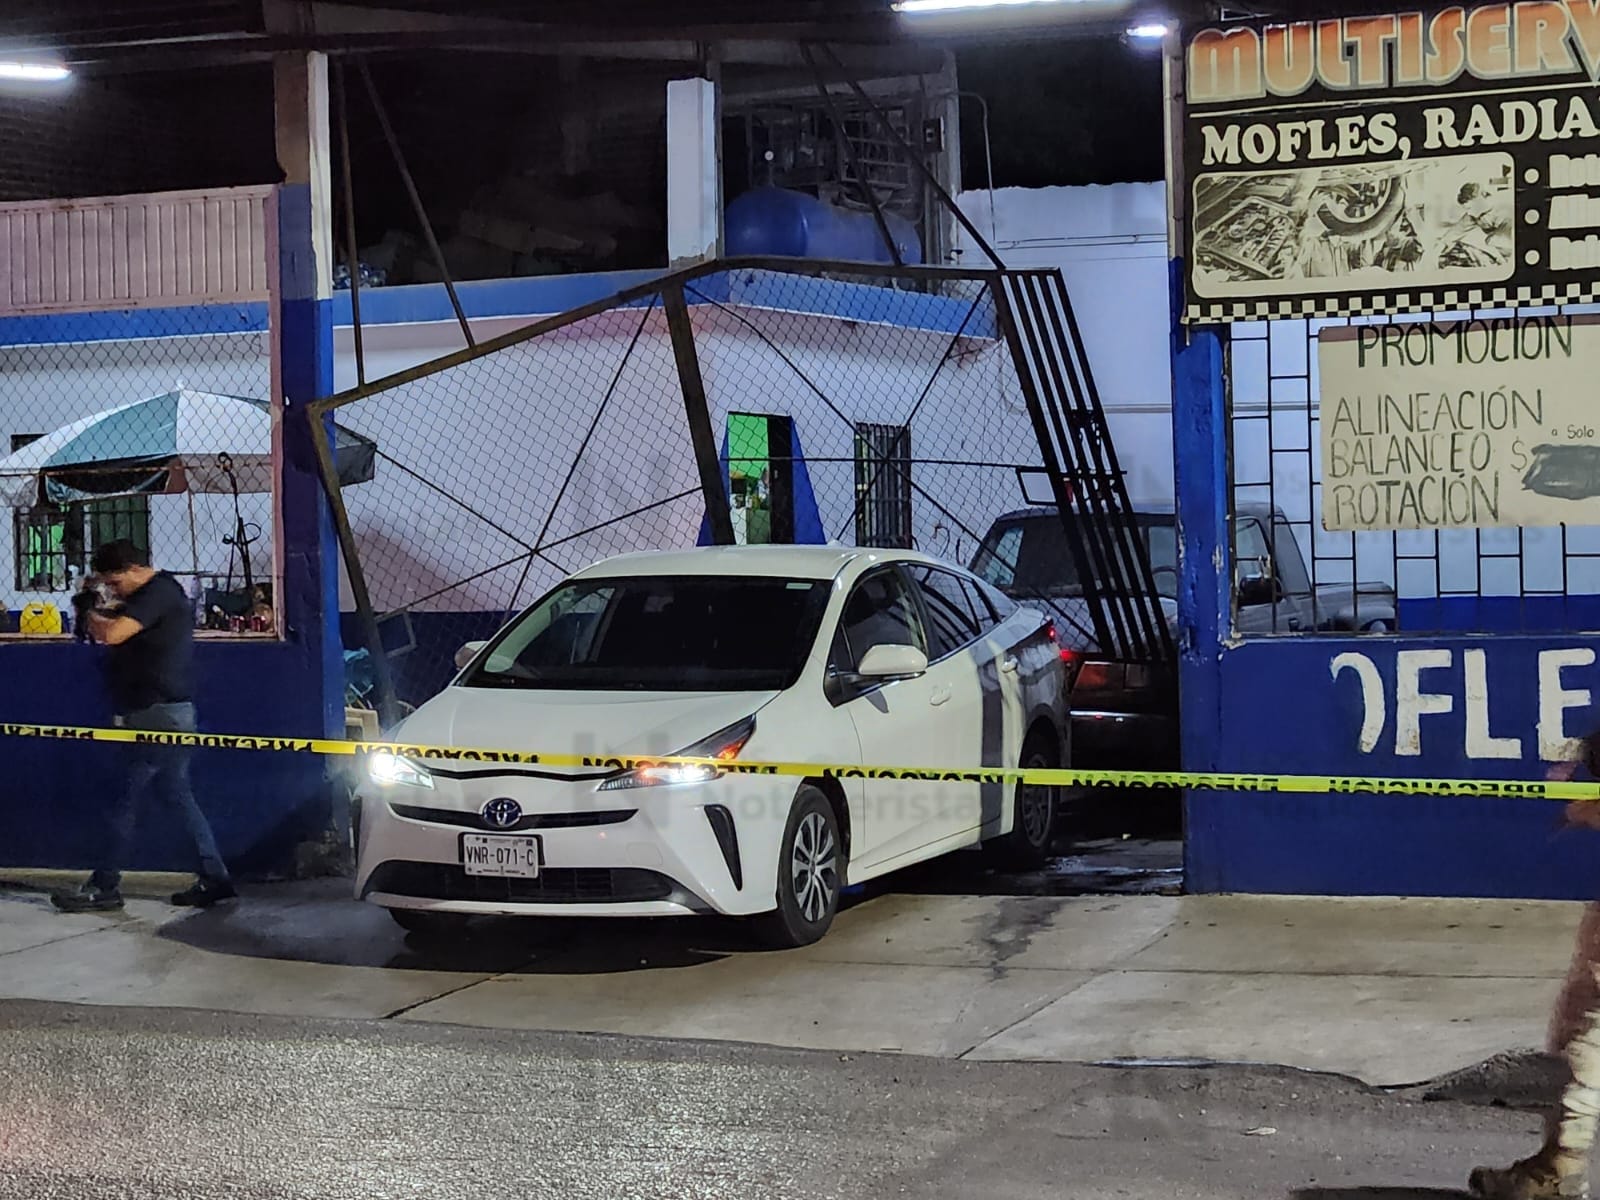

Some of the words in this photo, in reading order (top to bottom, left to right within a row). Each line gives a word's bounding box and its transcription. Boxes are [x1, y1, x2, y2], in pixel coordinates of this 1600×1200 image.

[1201, 113, 1412, 165] MOFLES,
[1331, 385, 1543, 437] ALINEACIÓN
[1567, 424, 1595, 439] Solo
[1328, 432, 1491, 478] BALANCEO
[1333, 471, 1500, 526] ROTACIÓN
[465, 845, 535, 867] VNR-071-C
